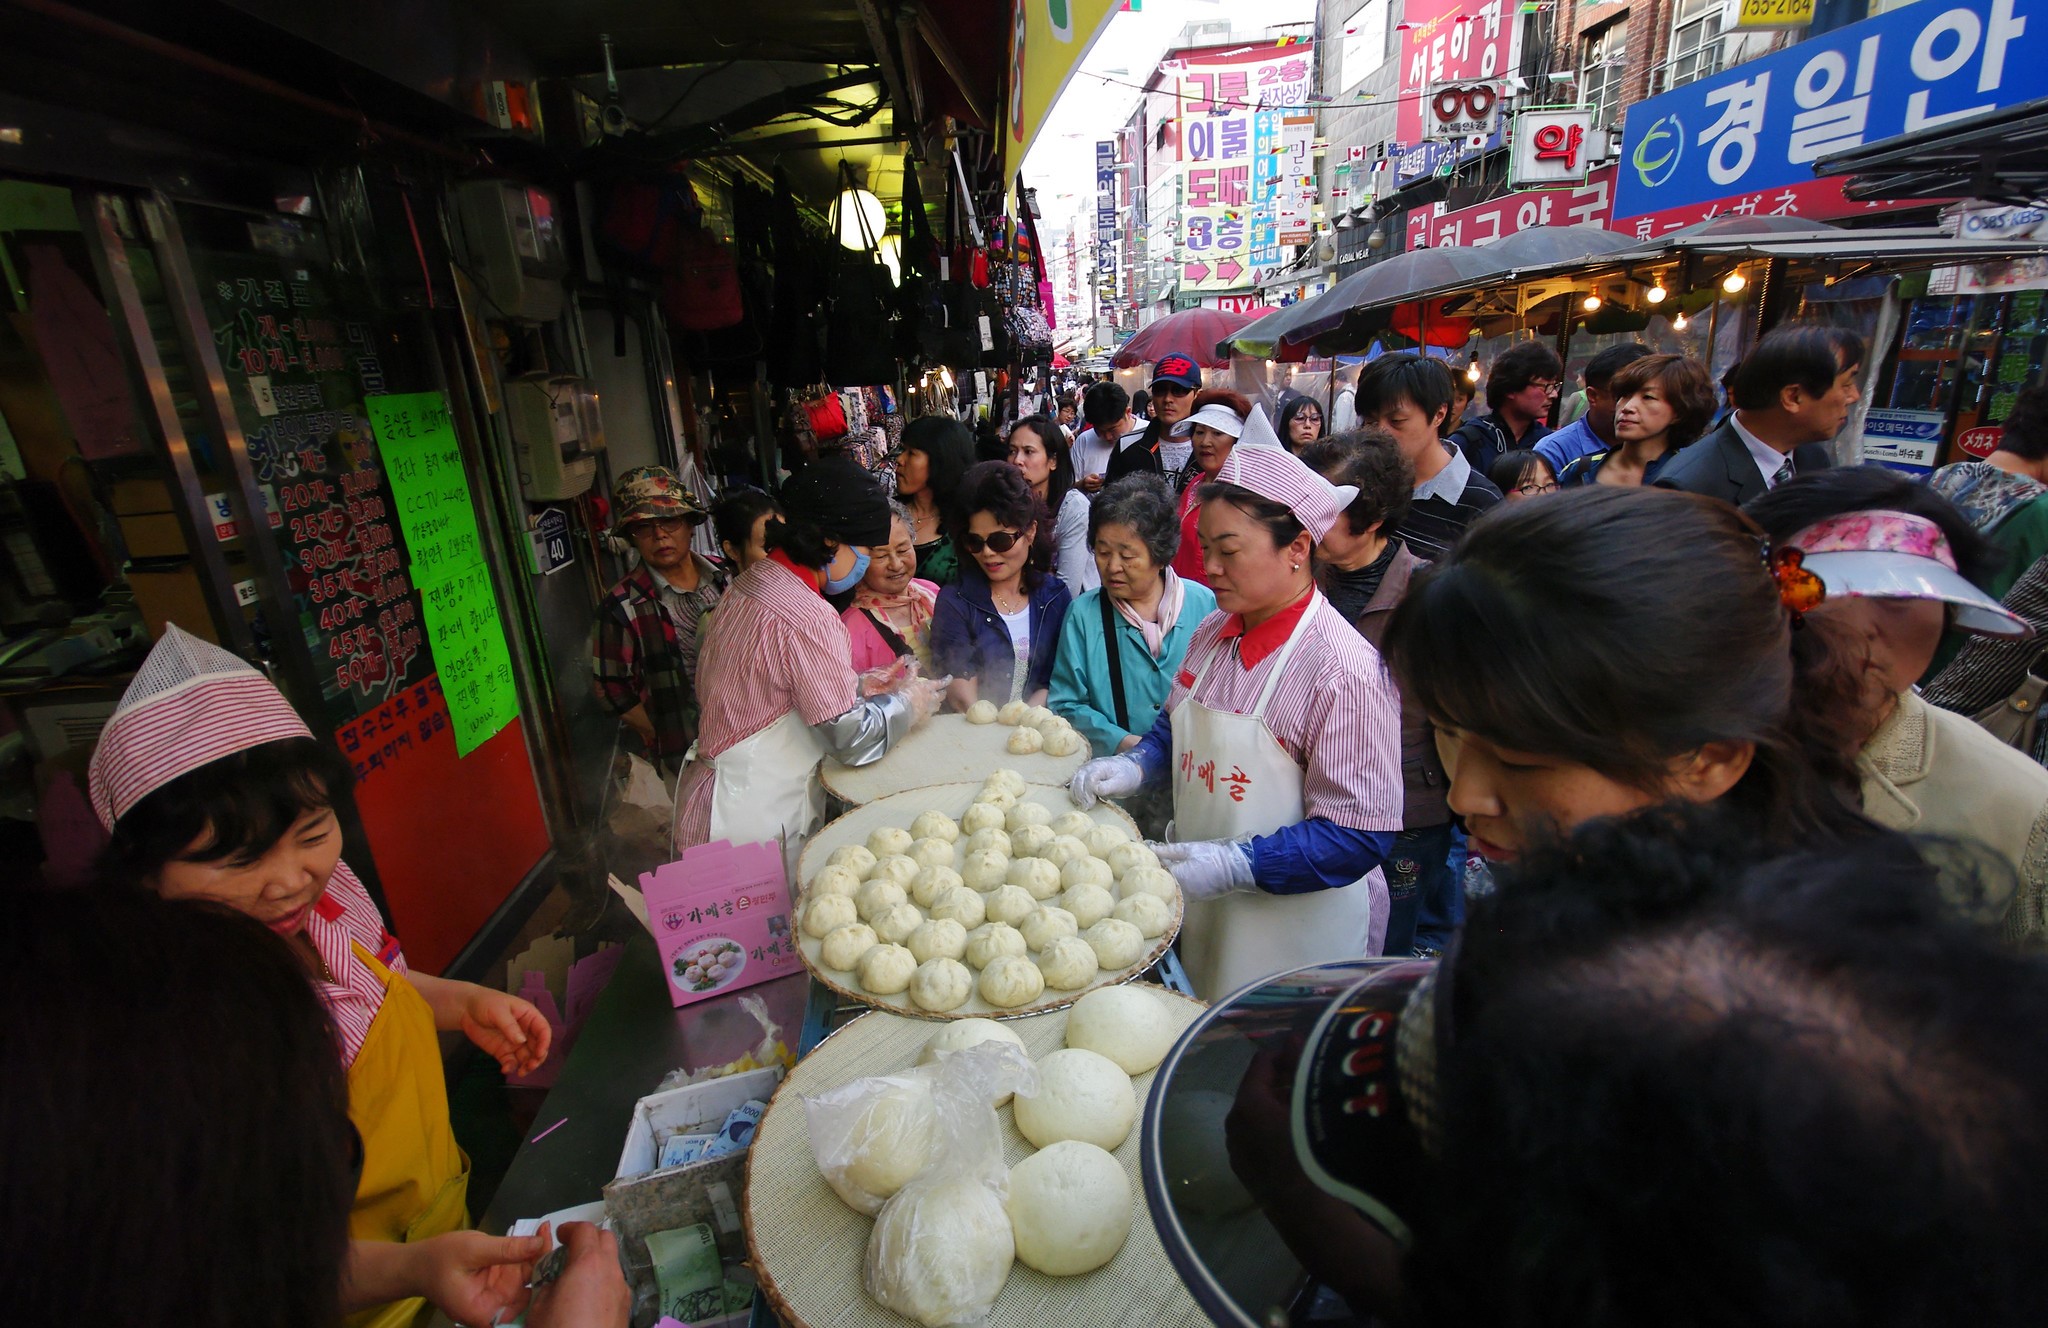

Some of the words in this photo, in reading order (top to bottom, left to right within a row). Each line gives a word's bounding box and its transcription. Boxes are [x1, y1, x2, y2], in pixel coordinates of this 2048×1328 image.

[1258, 59, 1308, 86] 2층
[1186, 71, 1249, 113] 그릇
[1188, 118, 1248, 159] 이불
[1532, 123, 1584, 170] 약
[1187, 165, 1249, 207] 도매
[1186, 215, 1244, 250] 3층
[1340, 252, 1355, 264] CASUAL
[1355, 248, 1369, 260] WEAR
[406, 489, 438, 514] CCTV
[550, 538, 565, 561] 40
[1181, 750, 1252, 802] 가메골
[742, 1106, 760, 1118] 1000
